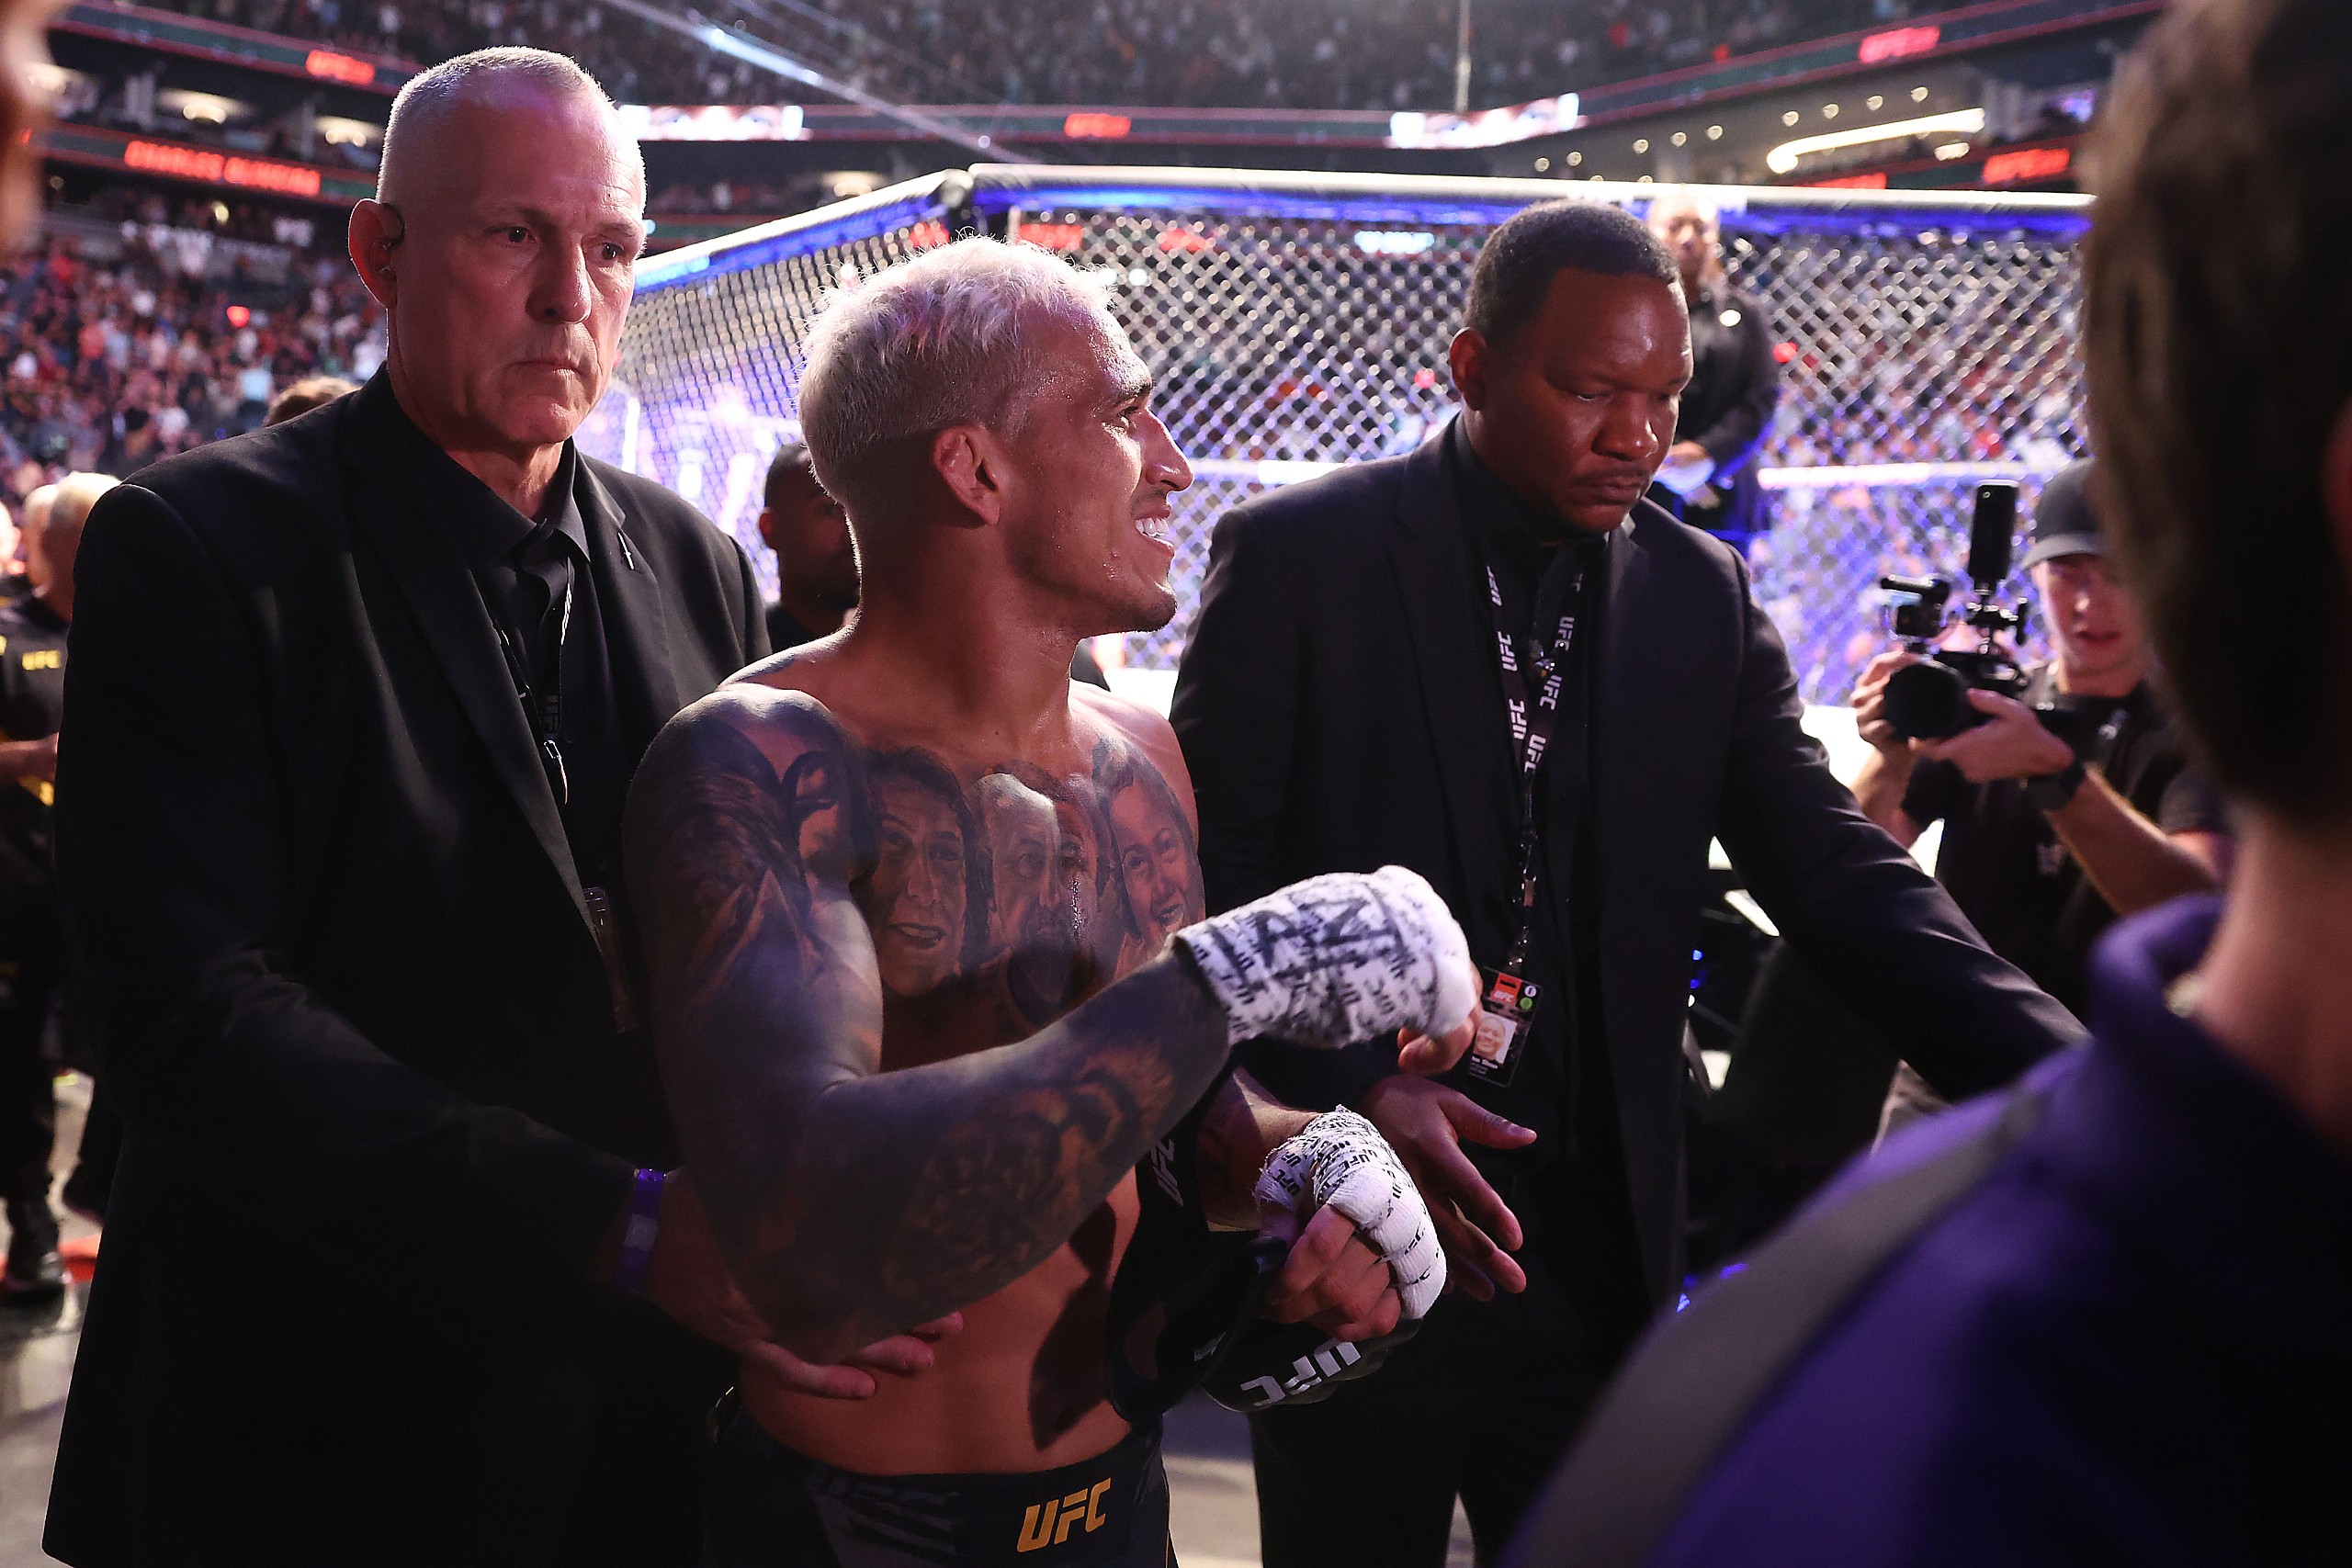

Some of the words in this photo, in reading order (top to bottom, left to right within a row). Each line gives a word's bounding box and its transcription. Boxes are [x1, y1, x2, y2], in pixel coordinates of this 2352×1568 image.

[1498, 630, 1519, 672] UFC
[1509, 698, 1528, 740] UFC
[1523, 734, 1547, 774] UFC
[1271, 1168, 1301, 1196] UFC
[1338, 1154, 1371, 1173] UFC
[1240, 1337, 1362, 1407] UFC
[1016, 1477, 1112, 1553] UFC
